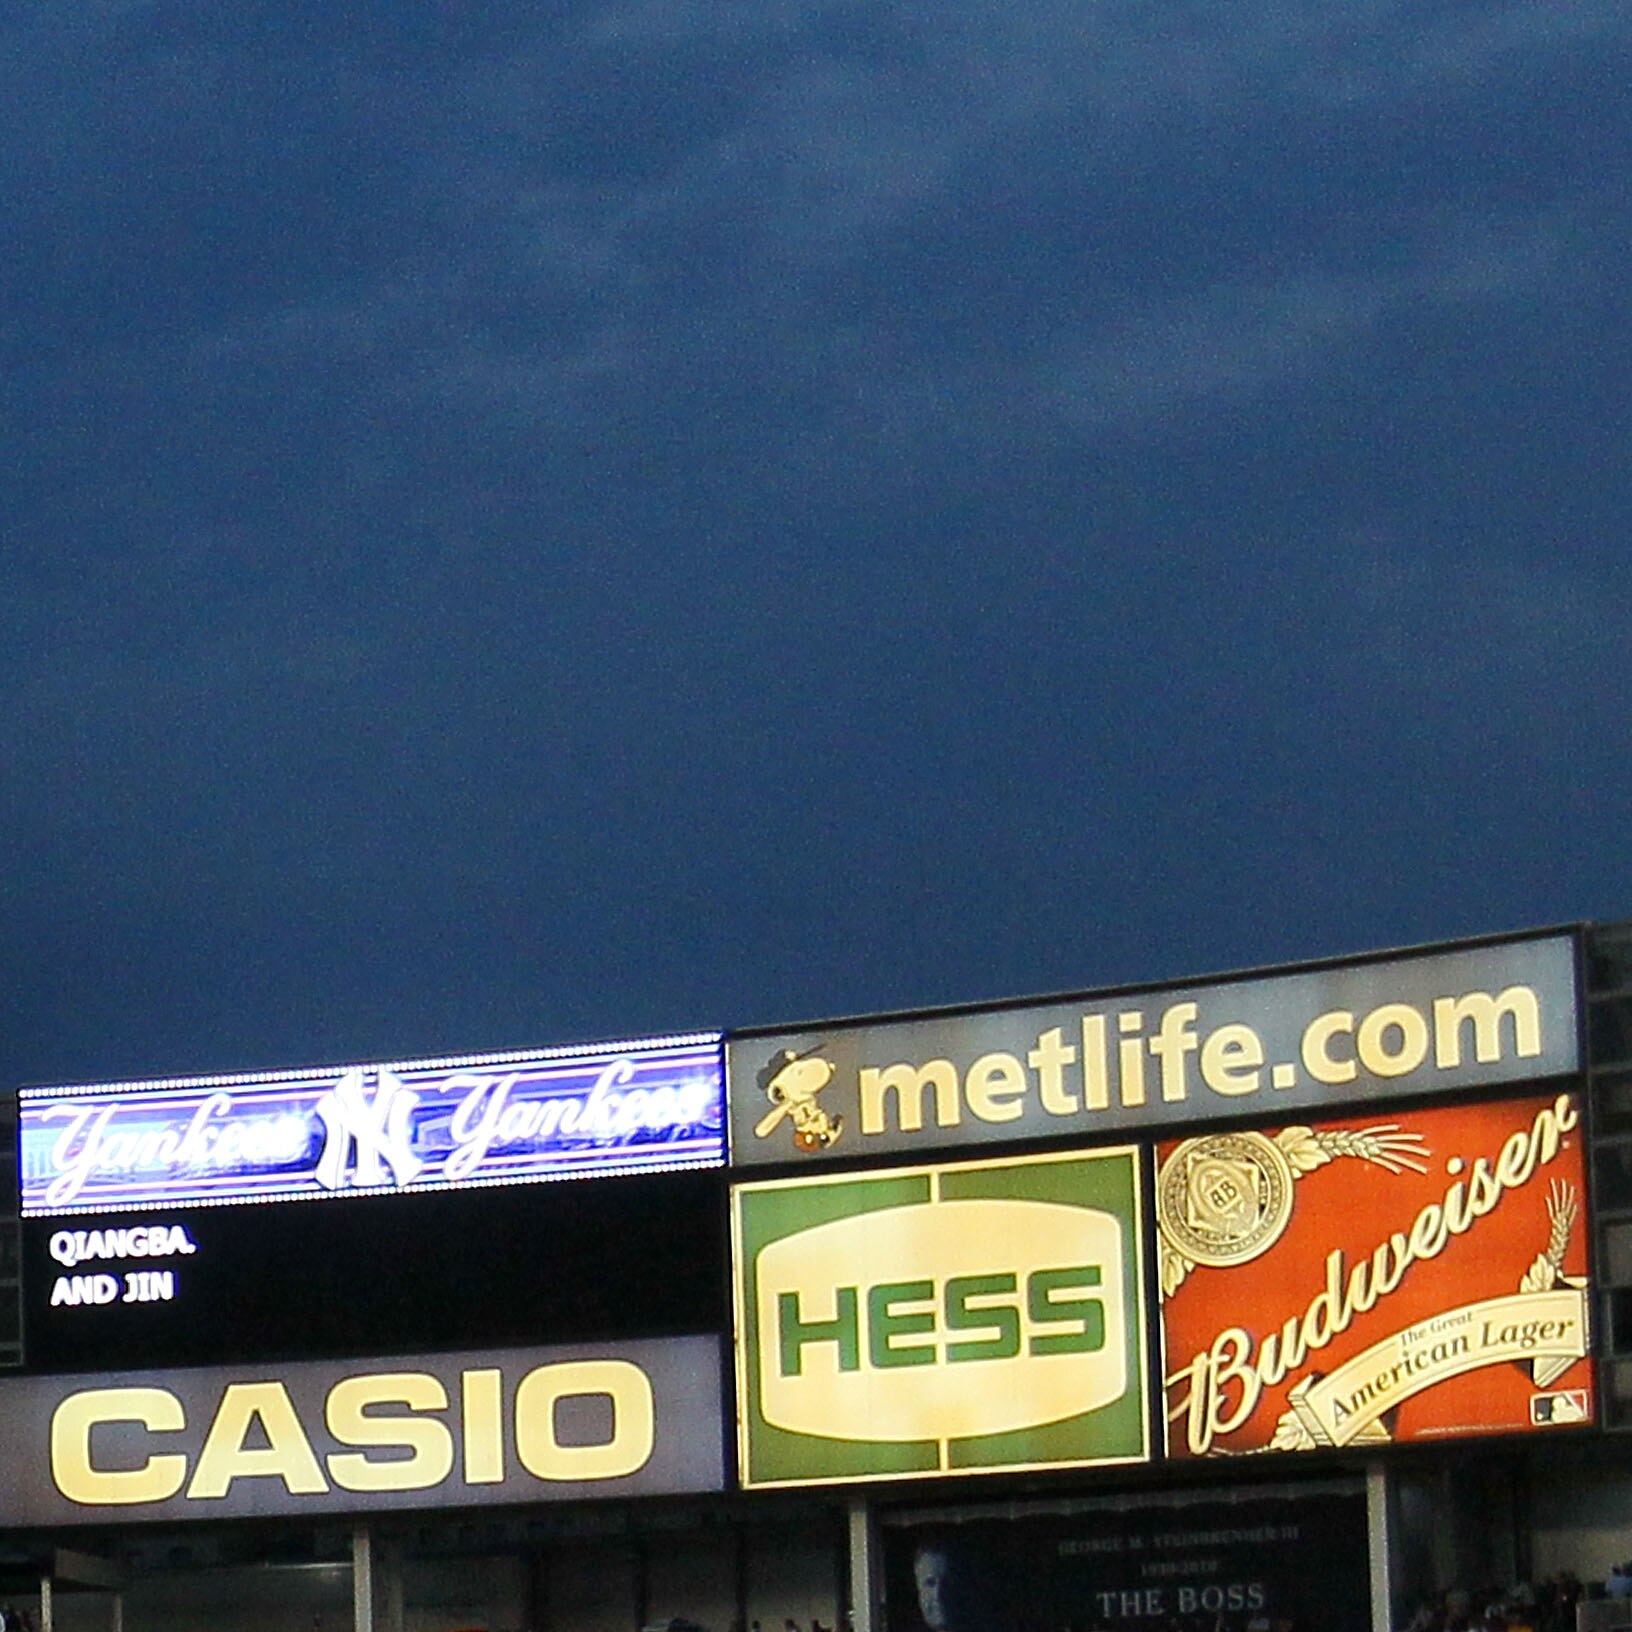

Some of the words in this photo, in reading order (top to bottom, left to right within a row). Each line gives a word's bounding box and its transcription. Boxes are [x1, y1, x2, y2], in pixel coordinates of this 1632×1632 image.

[859, 985, 1540, 1136] metlife.com
[42, 1094, 313, 1206] Yankees
[442, 1058, 716, 1181] Yankees
[49, 1275, 117, 1306] AND
[124, 1271, 174, 1300] JIN
[778, 1266, 1105, 1377] HESS
[1163, 1095, 1578, 1454] Budweiser
[1400, 1326, 1426, 1347] The
[1430, 1312, 1472, 1334] Great
[1332, 1334, 1468, 1426] American
[1482, 1321, 1574, 1348] Lager
[51, 1359, 654, 1505] CASIO
[1096, 1589, 1164, 1618] THE
[1178, 1584, 1265, 1613] BOSS
